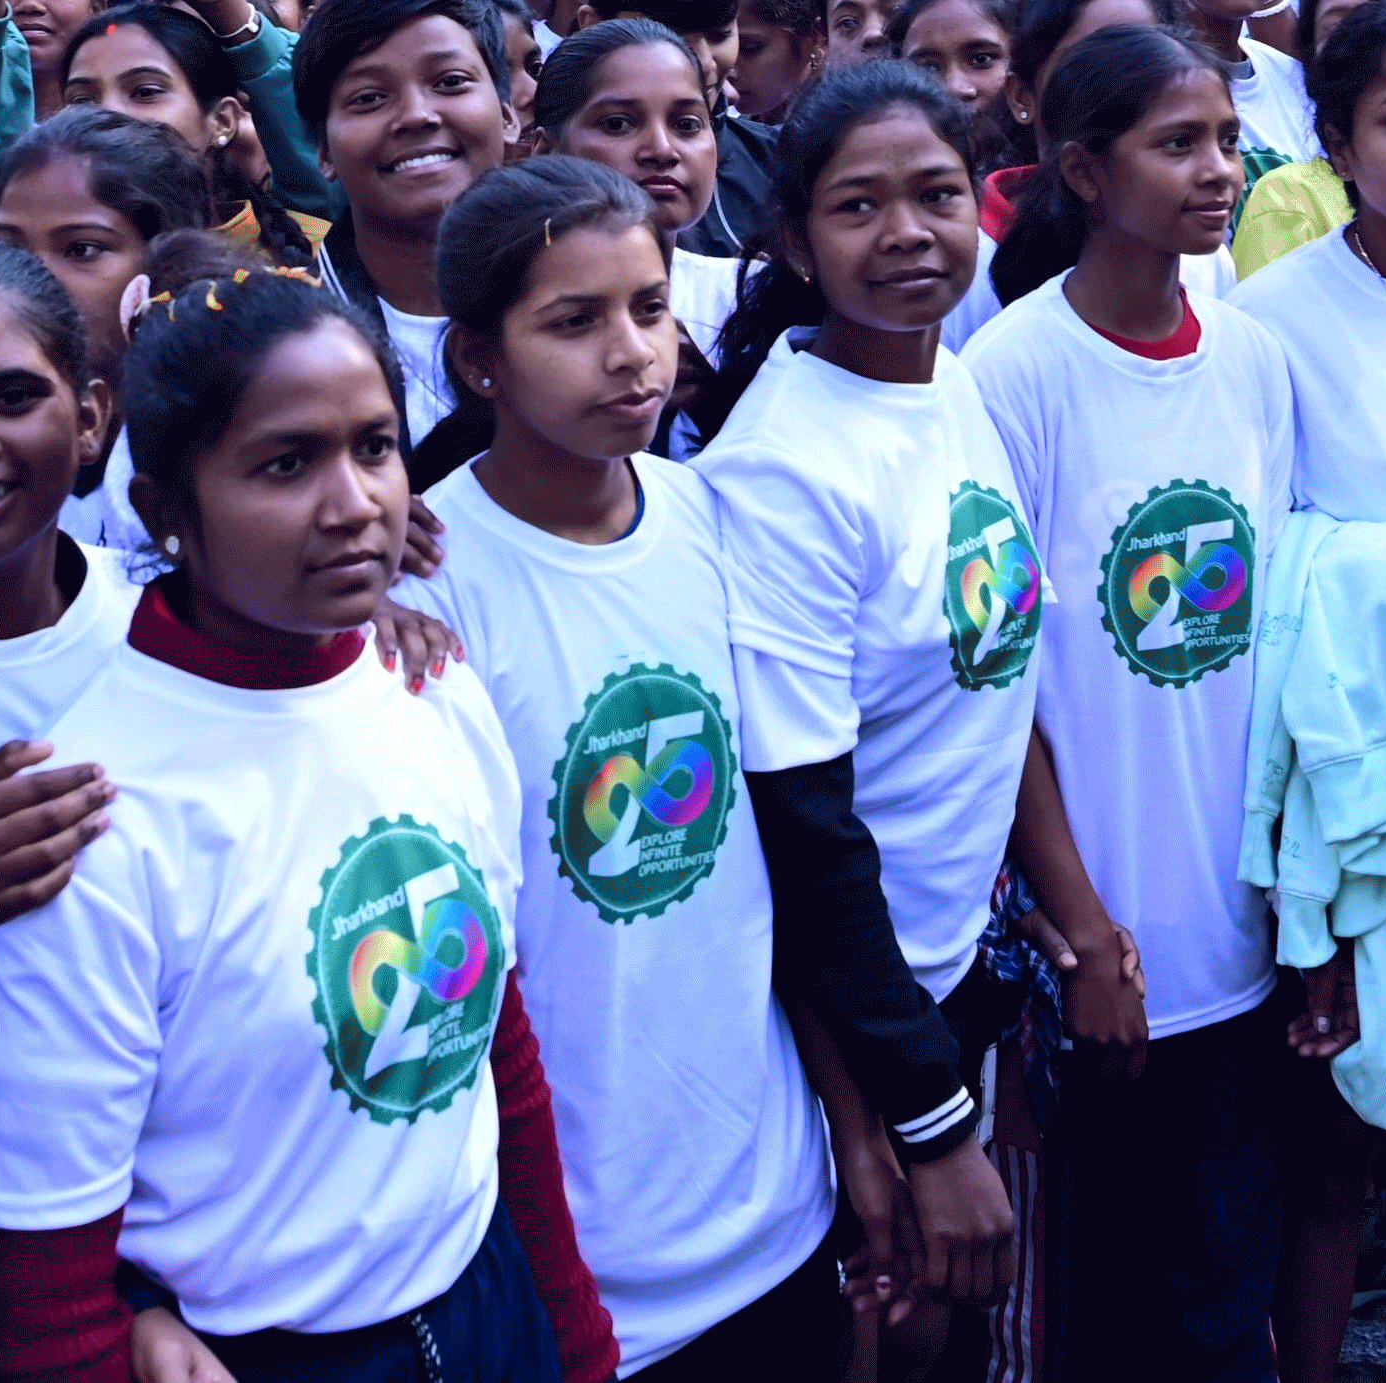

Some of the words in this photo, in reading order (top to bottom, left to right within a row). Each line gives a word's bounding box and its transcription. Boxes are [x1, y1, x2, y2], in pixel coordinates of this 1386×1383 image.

[1126, 528, 1187, 552] Jharkhand
[582, 721, 648, 755] Jharkhand
[331, 885, 406, 942] Jharkhand
